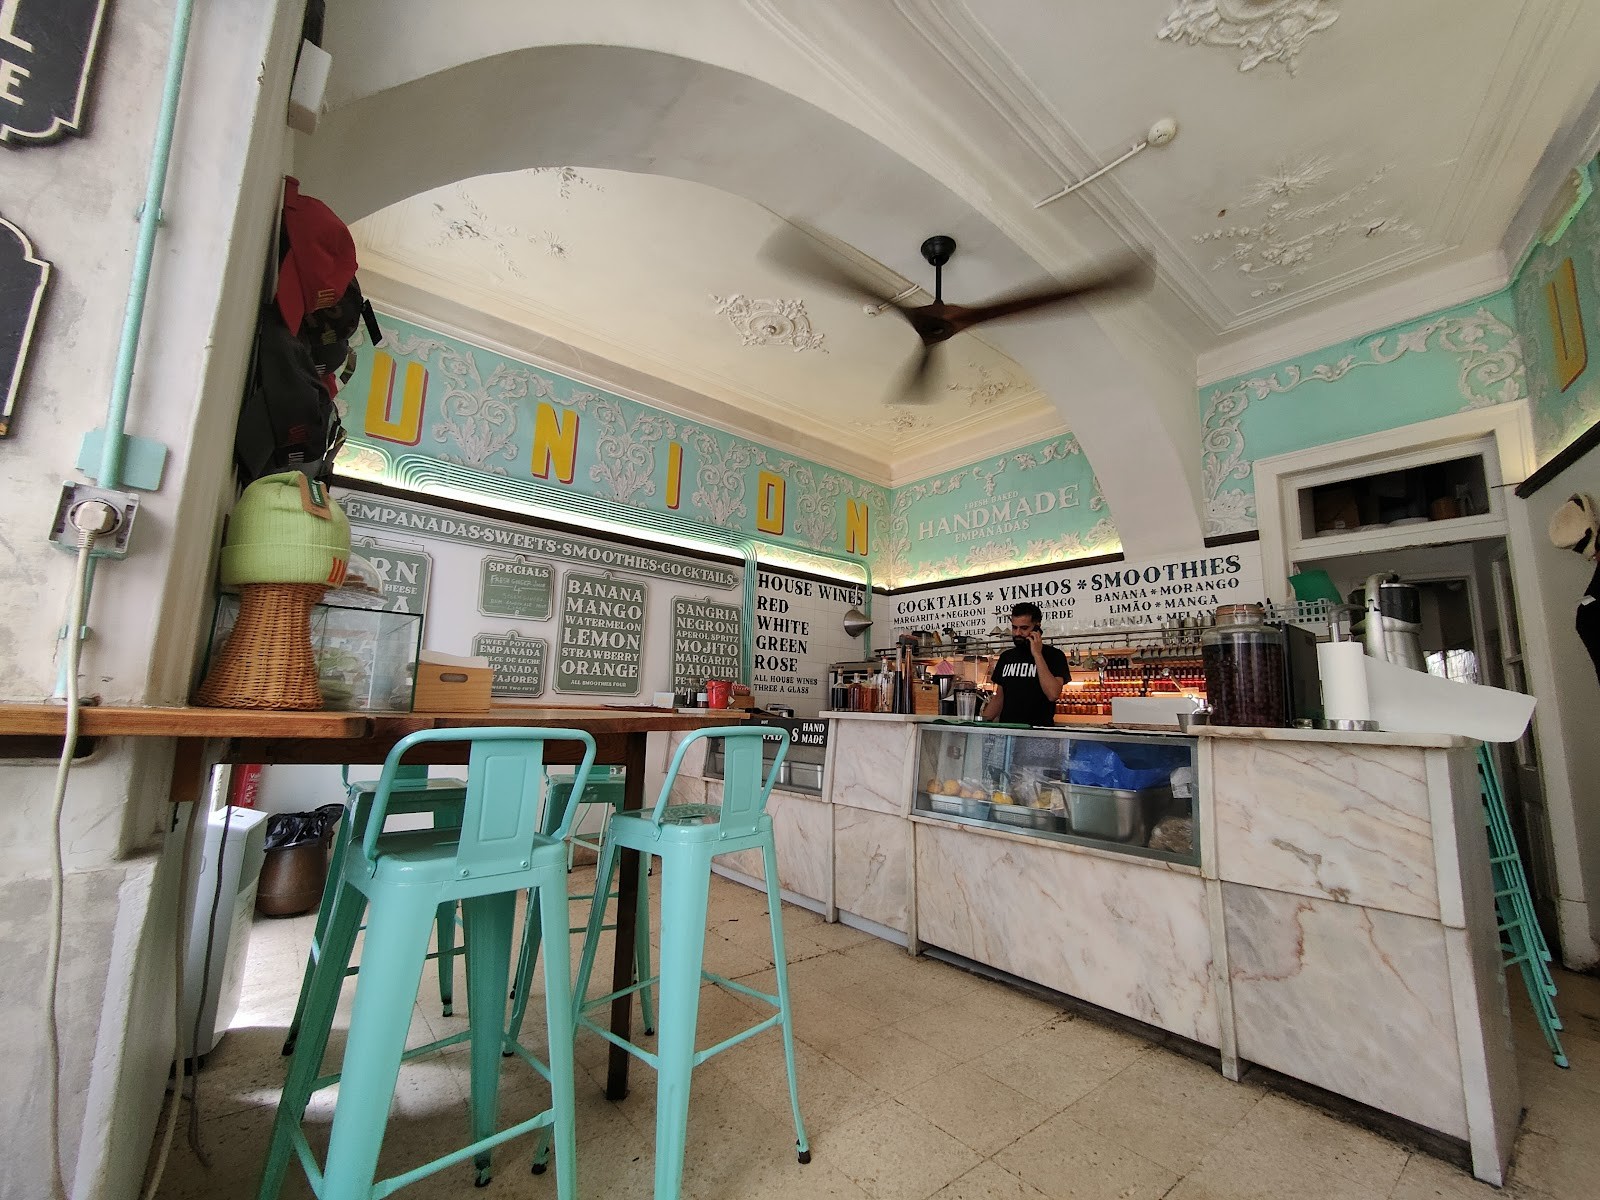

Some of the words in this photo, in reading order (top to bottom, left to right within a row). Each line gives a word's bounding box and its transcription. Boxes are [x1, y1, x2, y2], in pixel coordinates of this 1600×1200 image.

[364, 351, 869, 558] UNION
[964, 499, 989, 510] FRESH
[991, 491, 1019, 503] BAKED
[918, 484, 1080, 541] HANDMADE
[955, 519, 1030, 543] EMPANADAS
[346, 503, 480, 539] EMPANADAS
[483, 528, 556, 553] SWEETS
[562, 542, 658, 572] SMOOTHIES
[660, 563, 735, 585] COCKTAILS
[488, 562, 549, 578] SPECIALS
[384, 583, 418, 595] HEESE
[567, 579, 643, 603] BANANA
[758, 573, 812, 596] HOUSE
[818, 584, 864, 606] WINES
[897, 590, 981, 614] COCKTAILS
[999, 578, 1072, 601] VINHOS
[1091, 555, 1241, 591] SMOOTHIES
[1095, 588, 1147, 603] BANANA
[1160, 577, 1240, 596] MORANGO
[566, 597, 642, 620] MANGO
[676, 603, 738, 621] SANGRIA
[757, 595, 789, 613] RED
[995, 603, 1015, 613] ROS
[1109, 600, 1152, 614] LIMÃO
[1165, 594, 1219, 609] MANGA
[565, 615, 641, 632] WATERMELON
[676, 616, 739, 634] NEGRONI
[757, 615, 809, 635] WHITE
[893, 613, 940, 625] MARGARITA
[946, 607, 986, 619] NEGRONI
[1093, 614, 1153, 628] LARANJA
[921, 623, 941, 631] COLA
[965, 628, 986, 636] JULEP
[509, 641, 542, 649] POTATO
[563, 627, 640, 650] LEMON
[676, 630, 709, 640] APEROL
[711, 634, 739, 643] SPRITZ
[756, 635, 808, 654] GREEN
[480, 645, 540, 657] EMPANADA
[562, 647, 639, 662] STRAWBERRY
[676, 639, 738, 657] MOJITO
[560, 659, 638, 678] ORANGE
[675, 653, 738, 666] MARGARITA
[754, 654, 798, 672] ROSE
[675, 663, 739, 678] DAIQUIRI
[1002, 662, 1037, 677] UNION
[753, 684, 778, 692] THREE
[754, 674, 768, 682] ALL
[770, 675, 794, 683] HOUSE
[796, 677, 818, 685] WINES
[802, 722, 826, 733] HAND
[801, 733, 825, 744] MADE
